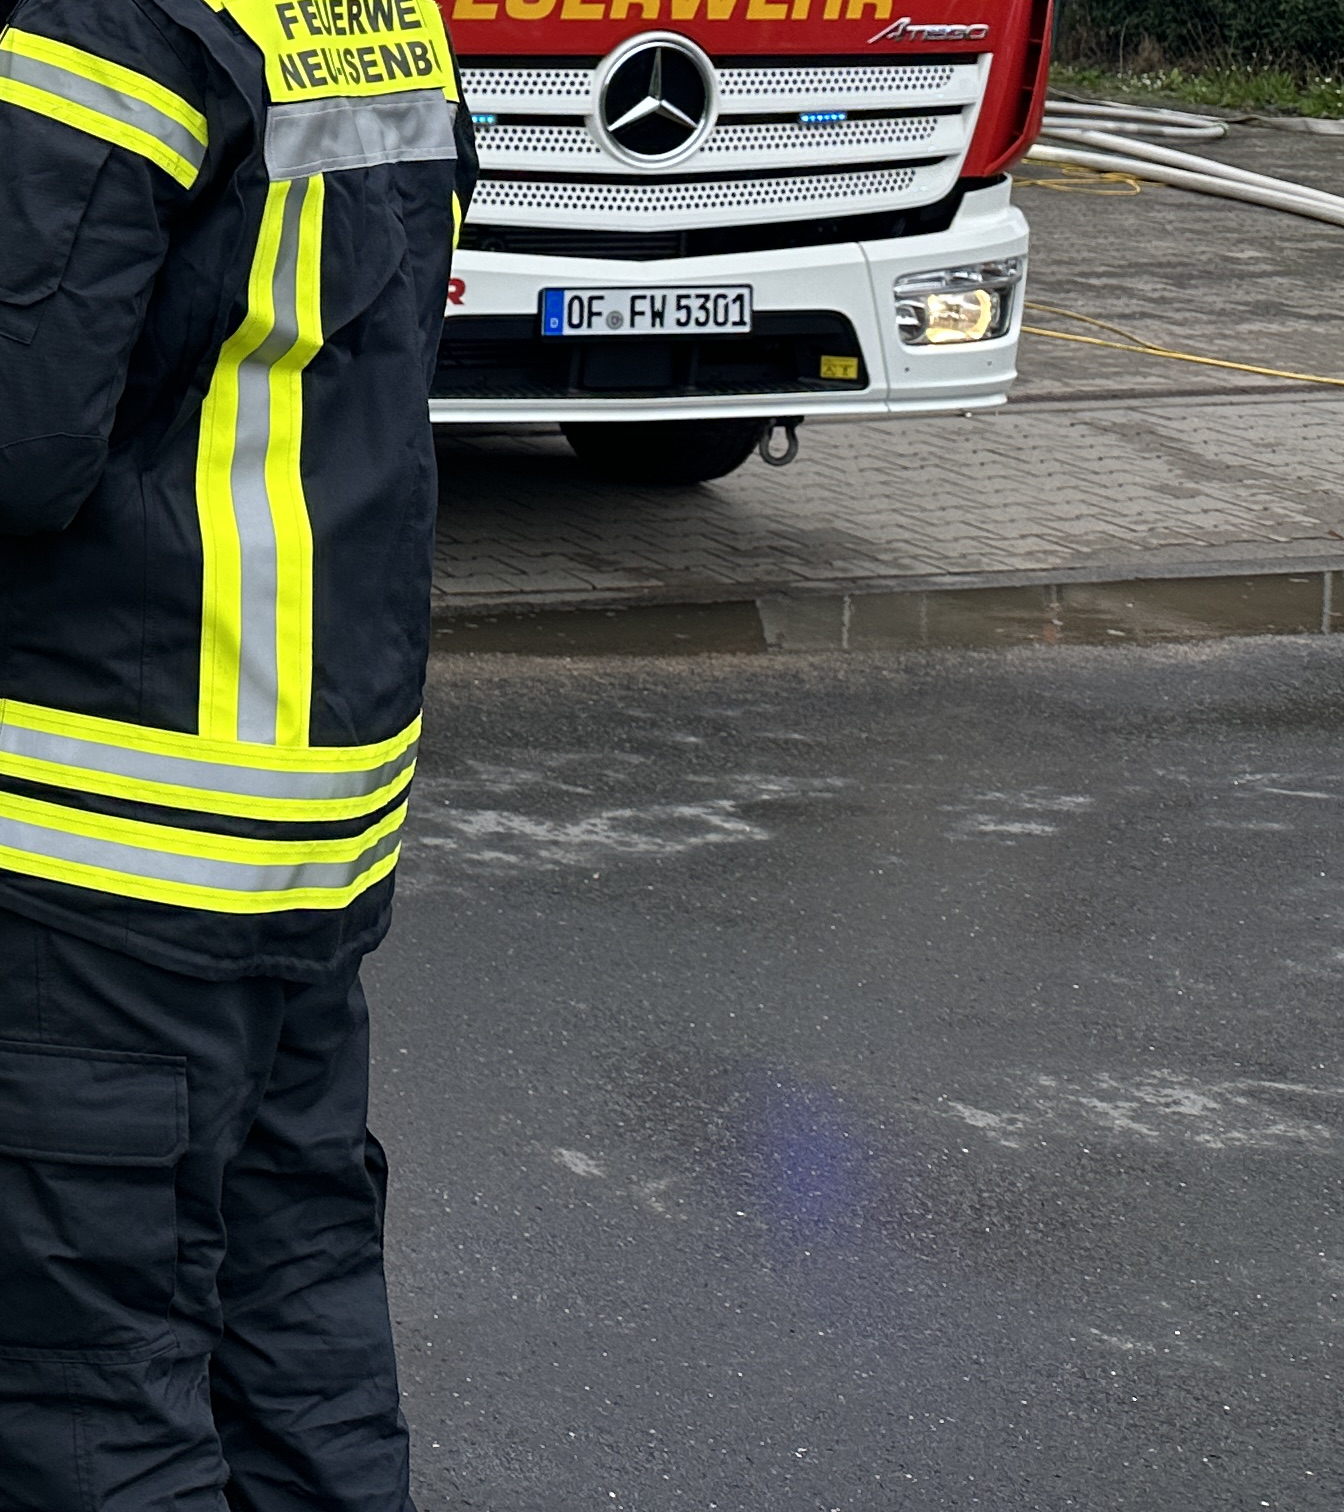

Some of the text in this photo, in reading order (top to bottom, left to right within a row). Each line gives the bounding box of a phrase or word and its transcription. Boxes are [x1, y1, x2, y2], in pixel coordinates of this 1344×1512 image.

[567, 293, 748, 329] OF FW 5301
